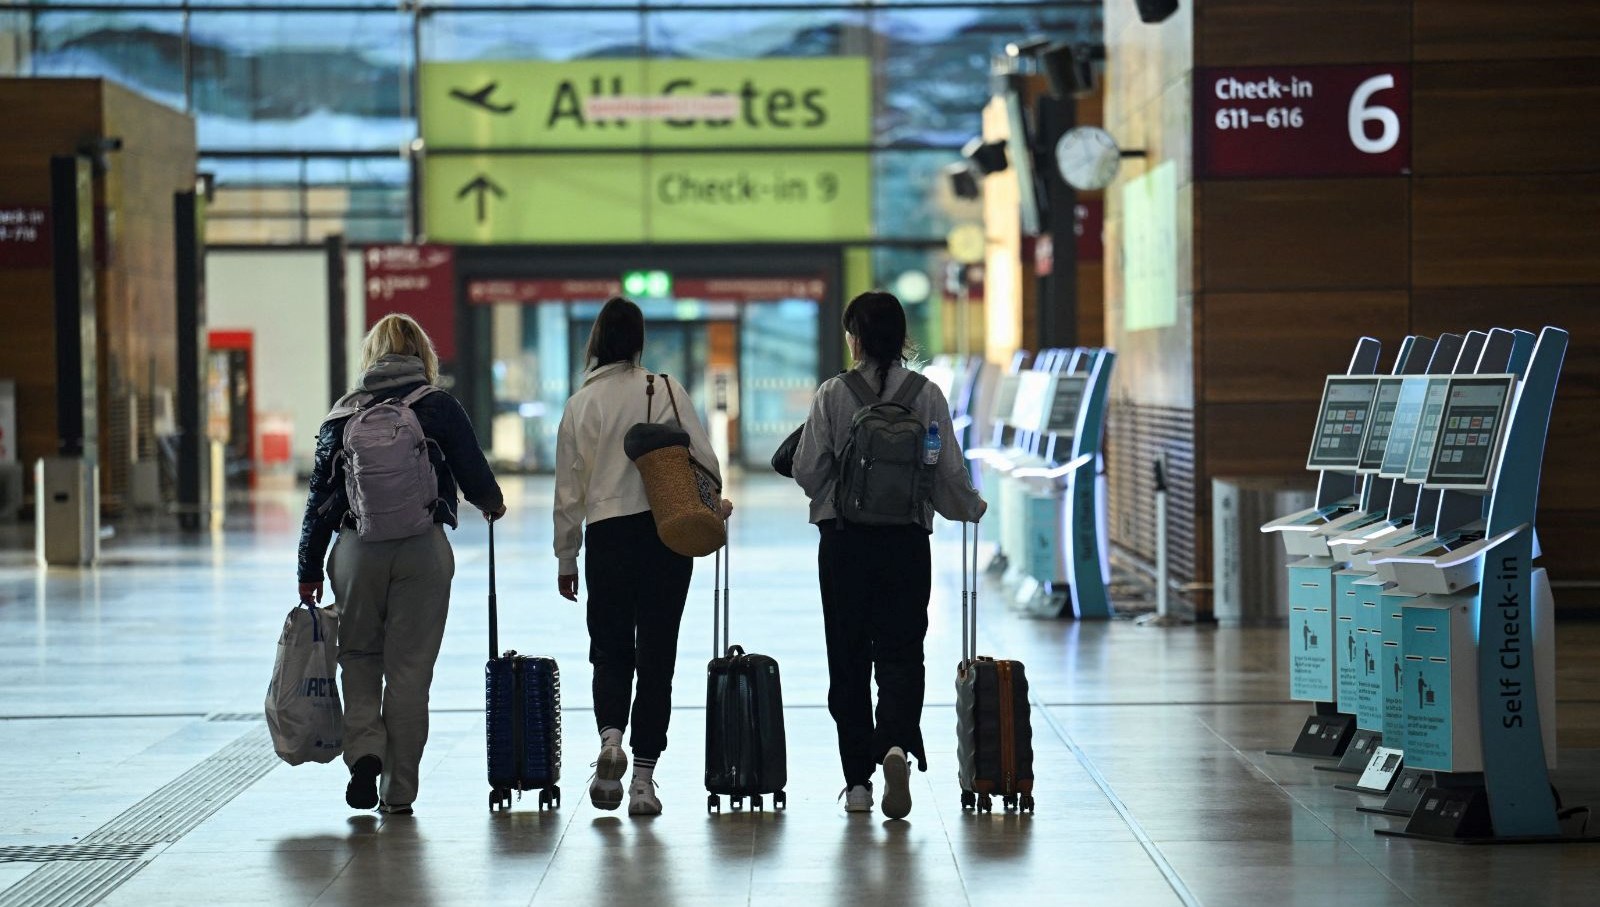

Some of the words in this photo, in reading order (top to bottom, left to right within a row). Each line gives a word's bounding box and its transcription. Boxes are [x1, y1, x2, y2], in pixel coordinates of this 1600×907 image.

[547, 76, 628, 129] All
[1215, 75, 1313, 99] Check-in
[1347, 73, 1401, 154] 6
[657, 168, 808, 205] Check-in
[816, 171, 839, 203] 9
[1497, 556, 1521, 670] Check-in
[1499, 678, 1522, 728] Self
